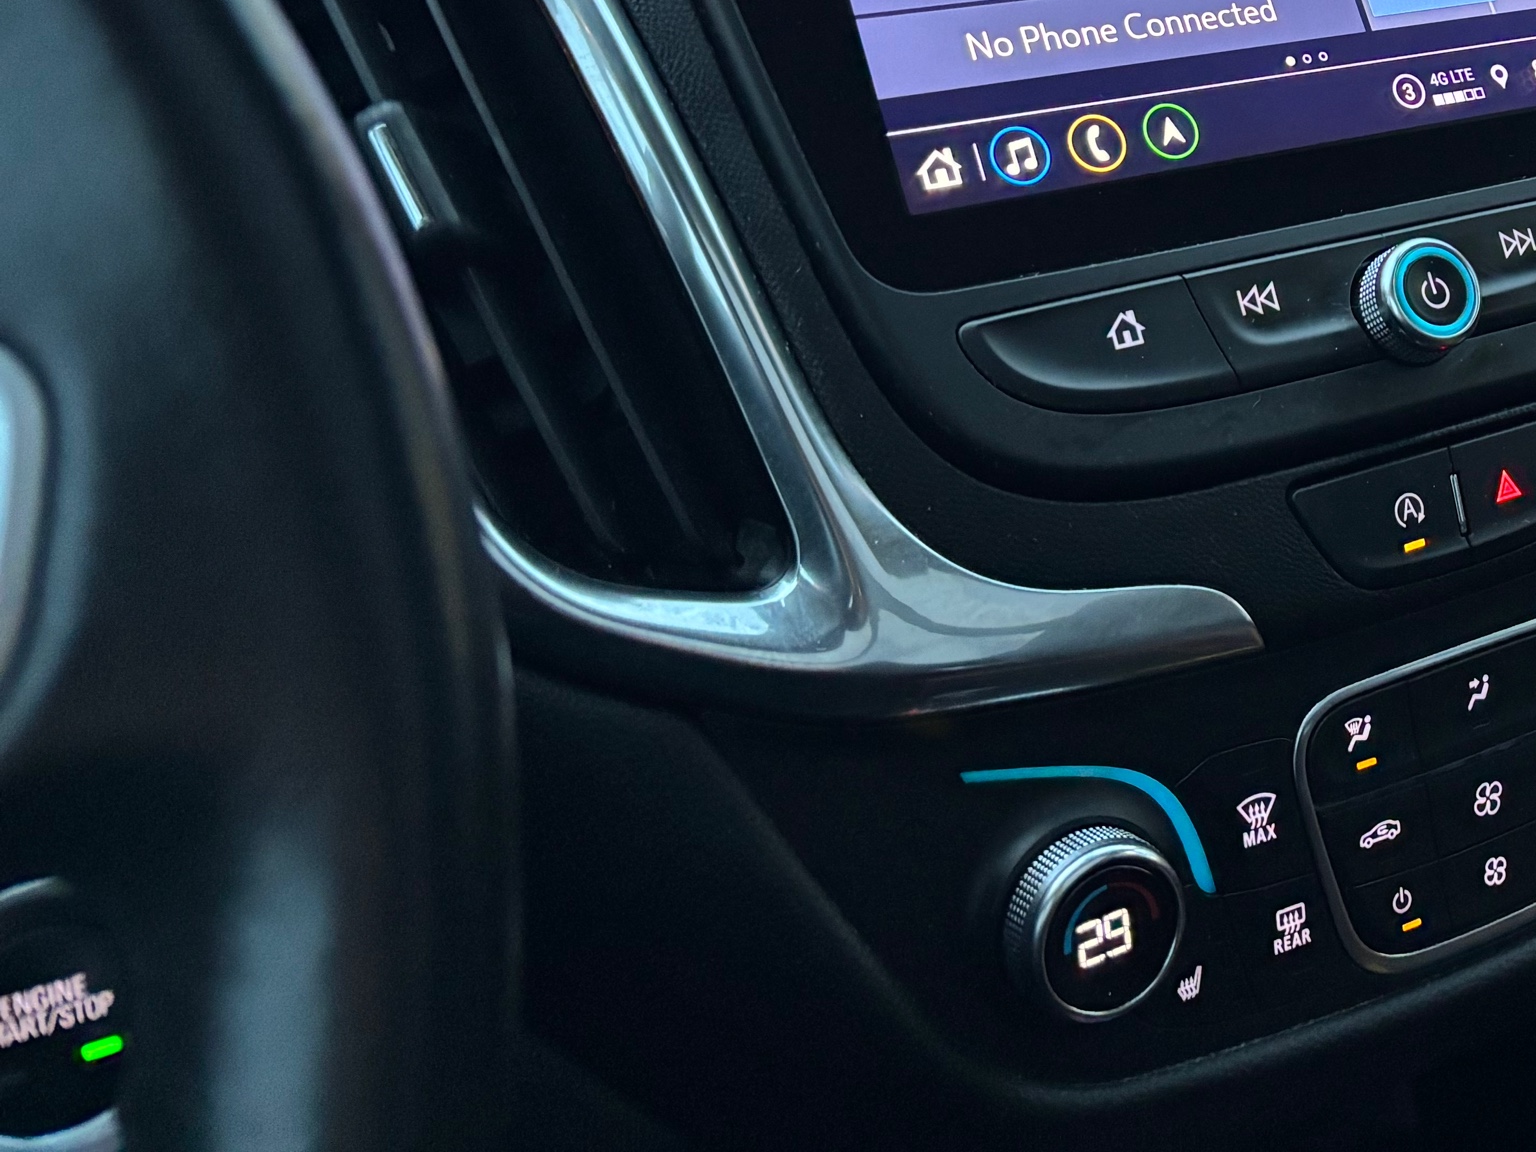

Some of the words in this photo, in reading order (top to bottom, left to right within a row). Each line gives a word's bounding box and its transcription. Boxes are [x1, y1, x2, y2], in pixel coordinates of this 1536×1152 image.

[966, 30, 1014, 61] No
[1020, 22, 1119, 54] Phone
[1430, 72, 1449, 87] 4G
[1450, 67, 1476, 84] LTE
[1401, 83, 1417, 103] 3
[1243, 822, 1277, 849] MAX
[1075, 906, 1134, 969] 29
[1273, 928, 1312, 956] REAR
[0, 971, 86, 1021] ENGINE
